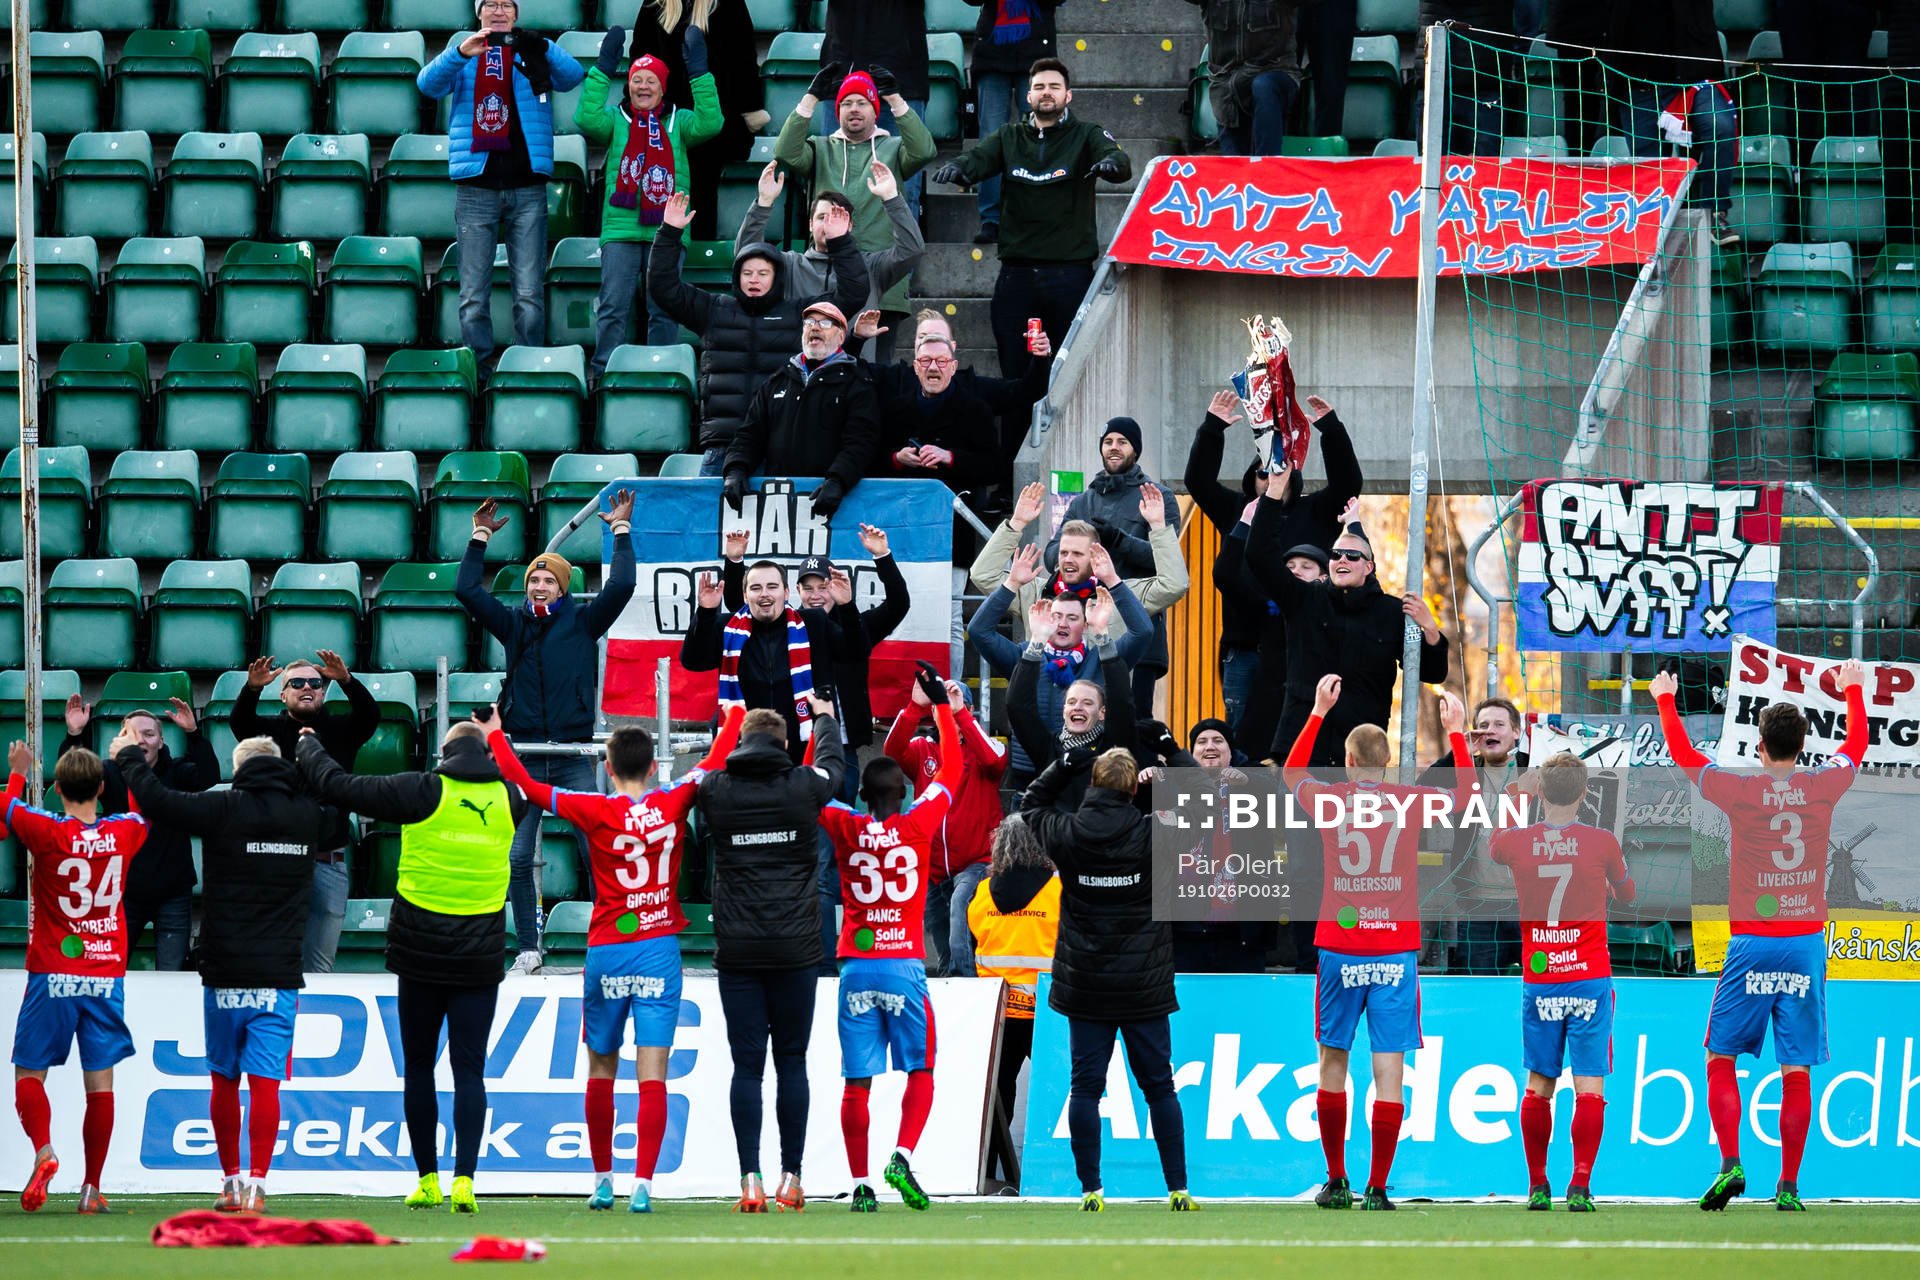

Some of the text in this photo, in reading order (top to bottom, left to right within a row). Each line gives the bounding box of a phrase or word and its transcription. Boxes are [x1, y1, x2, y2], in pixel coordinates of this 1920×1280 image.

[1012, 168, 1052, 181] ellesse
[1150, 161, 1674, 238] ÄKTA KÄRLEK
[1149, 229, 1392, 276] INGEN
[720, 481, 831, 557] HÄR
[1539, 480, 1762, 555] ANTI
[1762, 788, 1807, 810] inyett
[624, 806, 665, 834] inyett
[72, 833, 117, 858] inyett
[731, 830, 797, 846] HELSINGBORGS IF
[858, 826, 901, 851] inyett
[1337, 809, 1403, 876] 57
[1769, 812, 1806, 870] 3
[246, 842, 301, 855] HELSINGBORGS
[612, 822, 677, 889] 37
[1532, 837, 1578, 861] inyett
[849, 845, 919, 904] 33
[1078, 873, 1141, 887] HELSINGBORGS IF
[1757, 869, 1817, 887] LIVERSTAM
[57, 855, 123, 918] 34
[1333, 877, 1402, 892] HOLGERSSON
[626, 887, 670, 909] GIGOVIC
[1537, 863, 1573, 927] 7
[1779, 894, 1808, 908] Solid
[639, 906, 669, 925] Solid
[866, 908, 902, 922] BANCE
[1359, 907, 1390, 920] Solid
[1779, 905, 1816, 917] Försäkring
[1359, 920, 1398, 931] Försäkring
[875, 928, 906, 941] Solid
[1532, 927, 1581, 944] RANDRUP
[1823, 921, 1920, 962] kånsk
[83, 940, 113, 952] Solid
[874, 940, 913, 951] Försäkring
[1548, 949, 1578, 965] Solid
[1340, 962, 1405, 976] ÖRESUNDS
[1548, 961, 1588, 974] Försäkring
[600, 974, 666, 988] ÖRESUNDS
[1342, 973, 1404, 989] KRAFT
[1745, 970, 1811, 985] ÖRESUNDS
[48, 983, 114, 999] KRAFT
[602, 985, 666, 999] KRAFT
[1745, 980, 1811, 998] KRAFT
[215, 994, 278, 1013] KRAFT
[1008, 993, 1034, 1005] OLLS
[1535, 996, 1598, 1009] ÖRESUNDS
[1537, 1006, 1597, 1022] KRAFT
